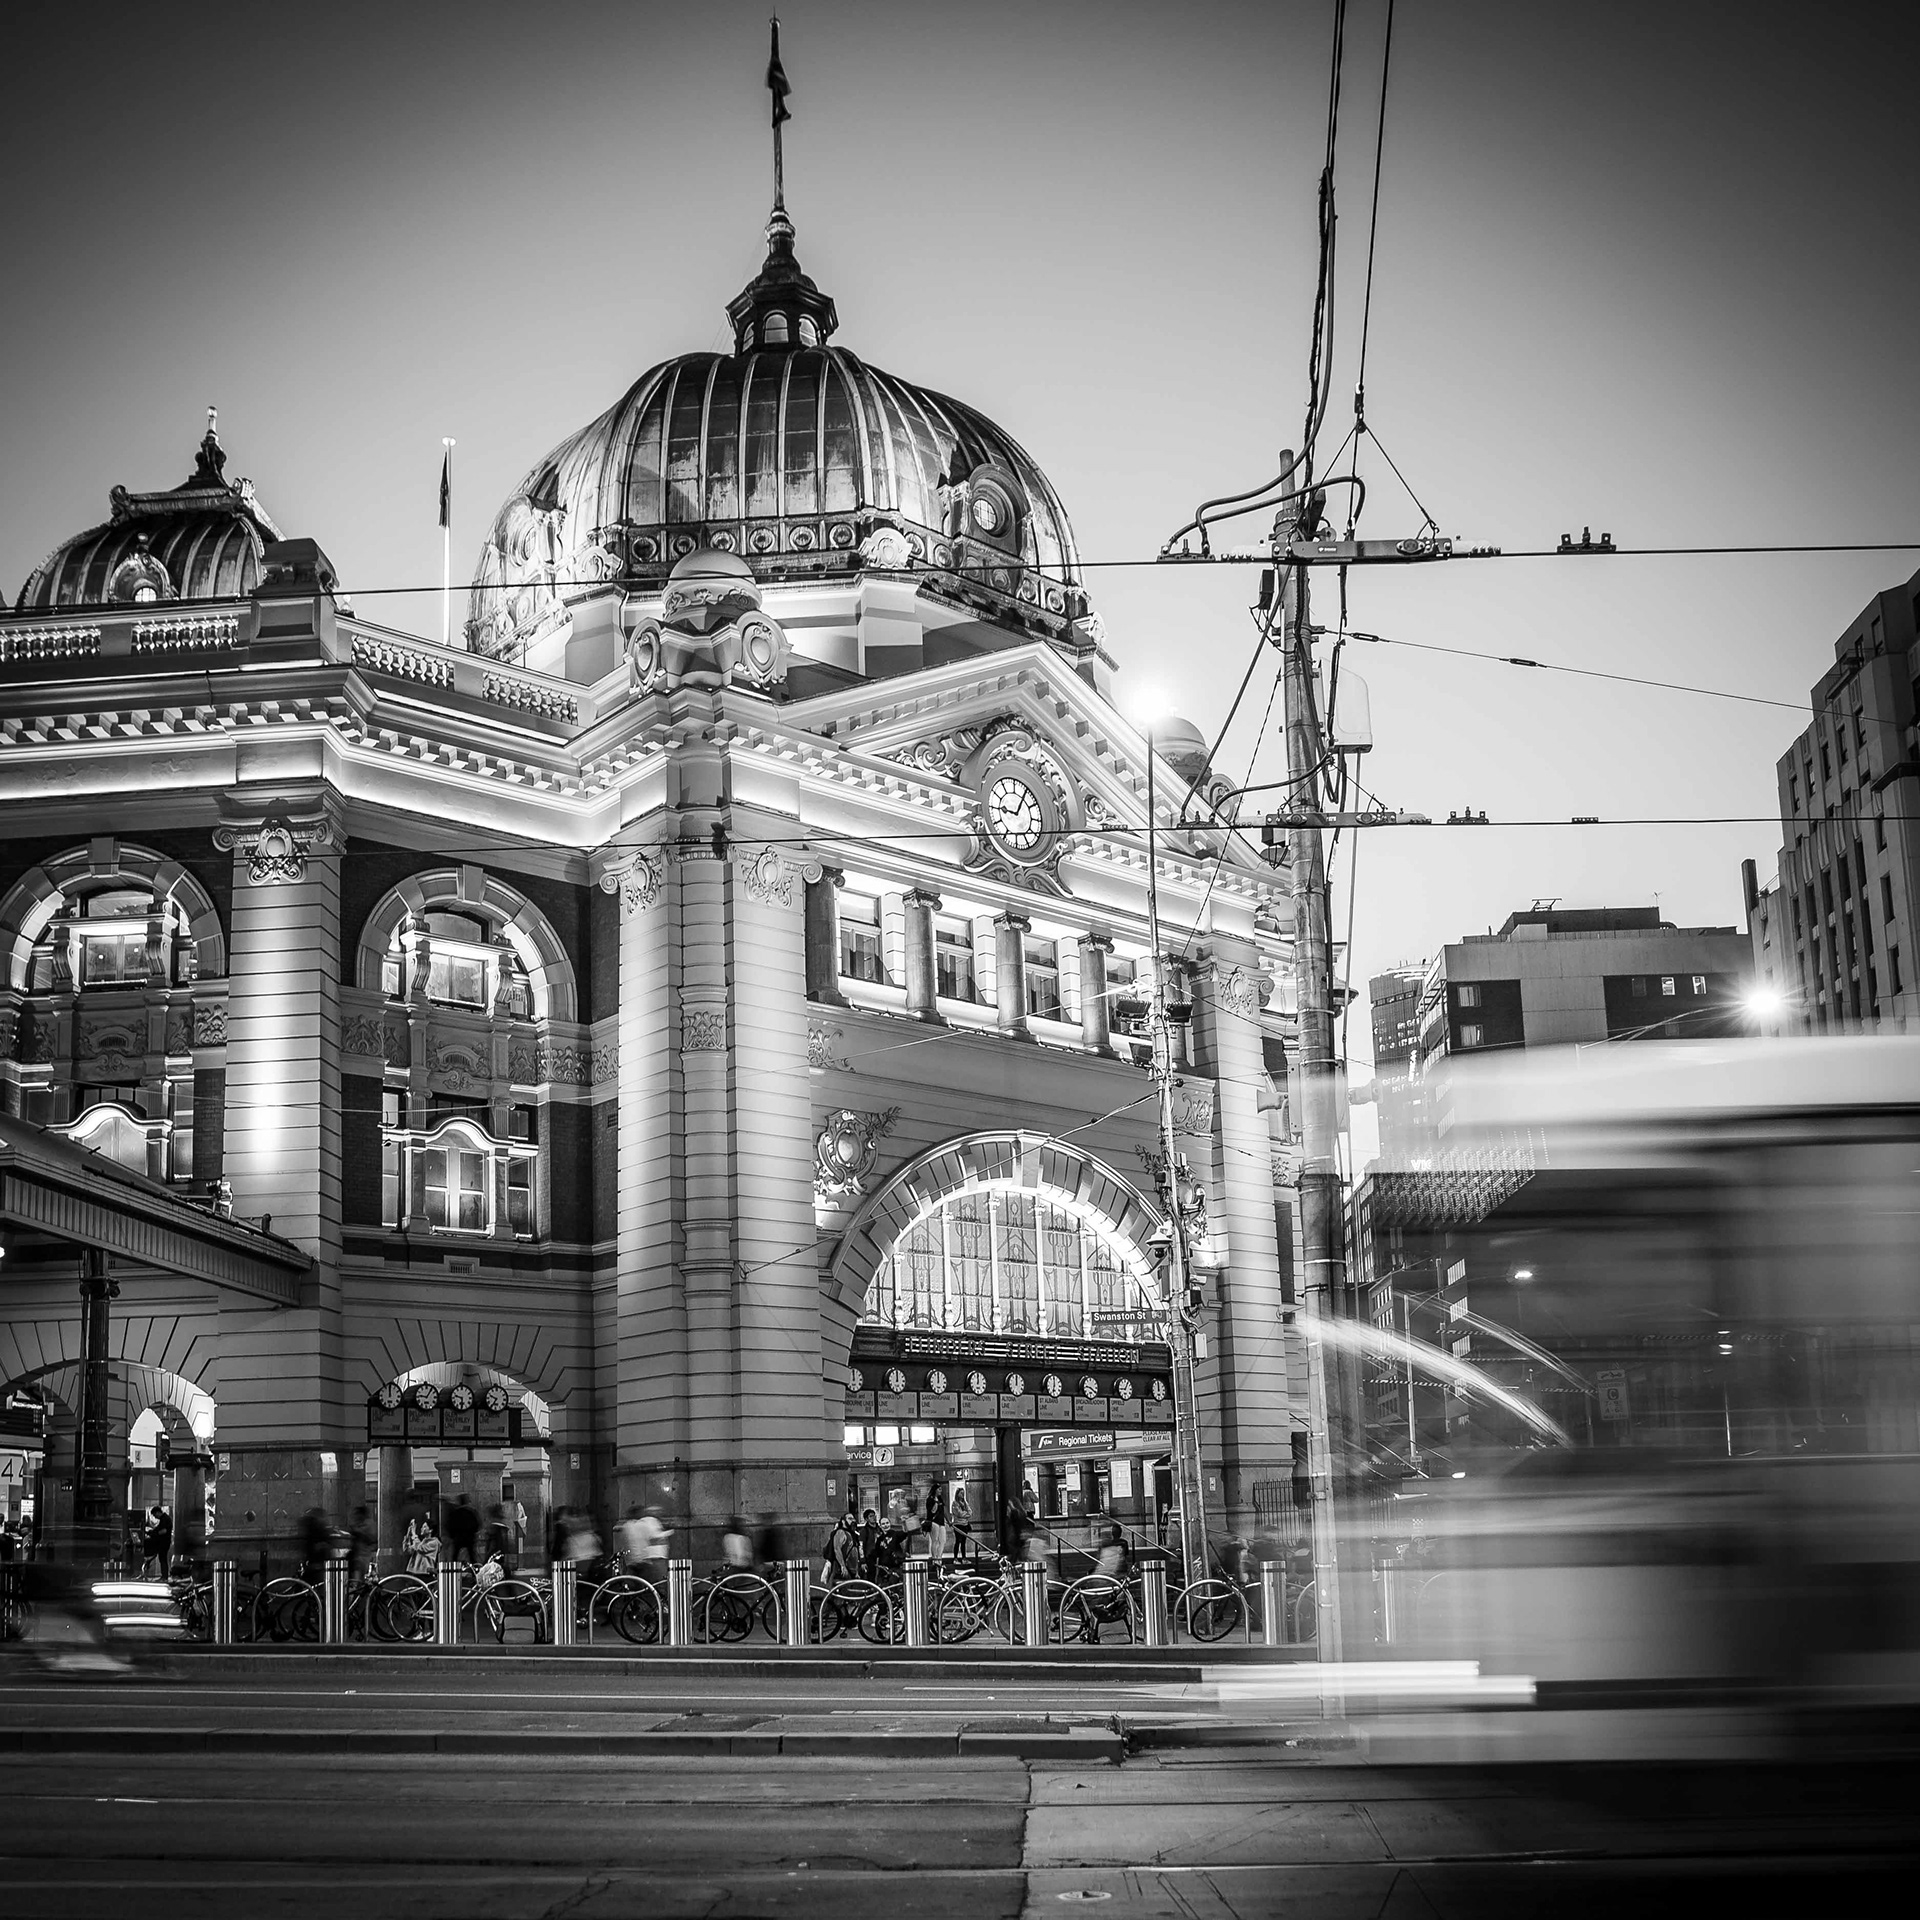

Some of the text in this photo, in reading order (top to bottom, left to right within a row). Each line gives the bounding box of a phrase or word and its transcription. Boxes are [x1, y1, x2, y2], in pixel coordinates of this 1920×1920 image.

[1093, 1311, 1146, 1321] Swanston St
[909, 1336, 1139, 1363] FLINDERS STREET STATION
[1058, 1435, 1087, 1447] Regional
[1088, 1433, 1113, 1444] Tickets
[846, 1448, 872, 1460] ervice
